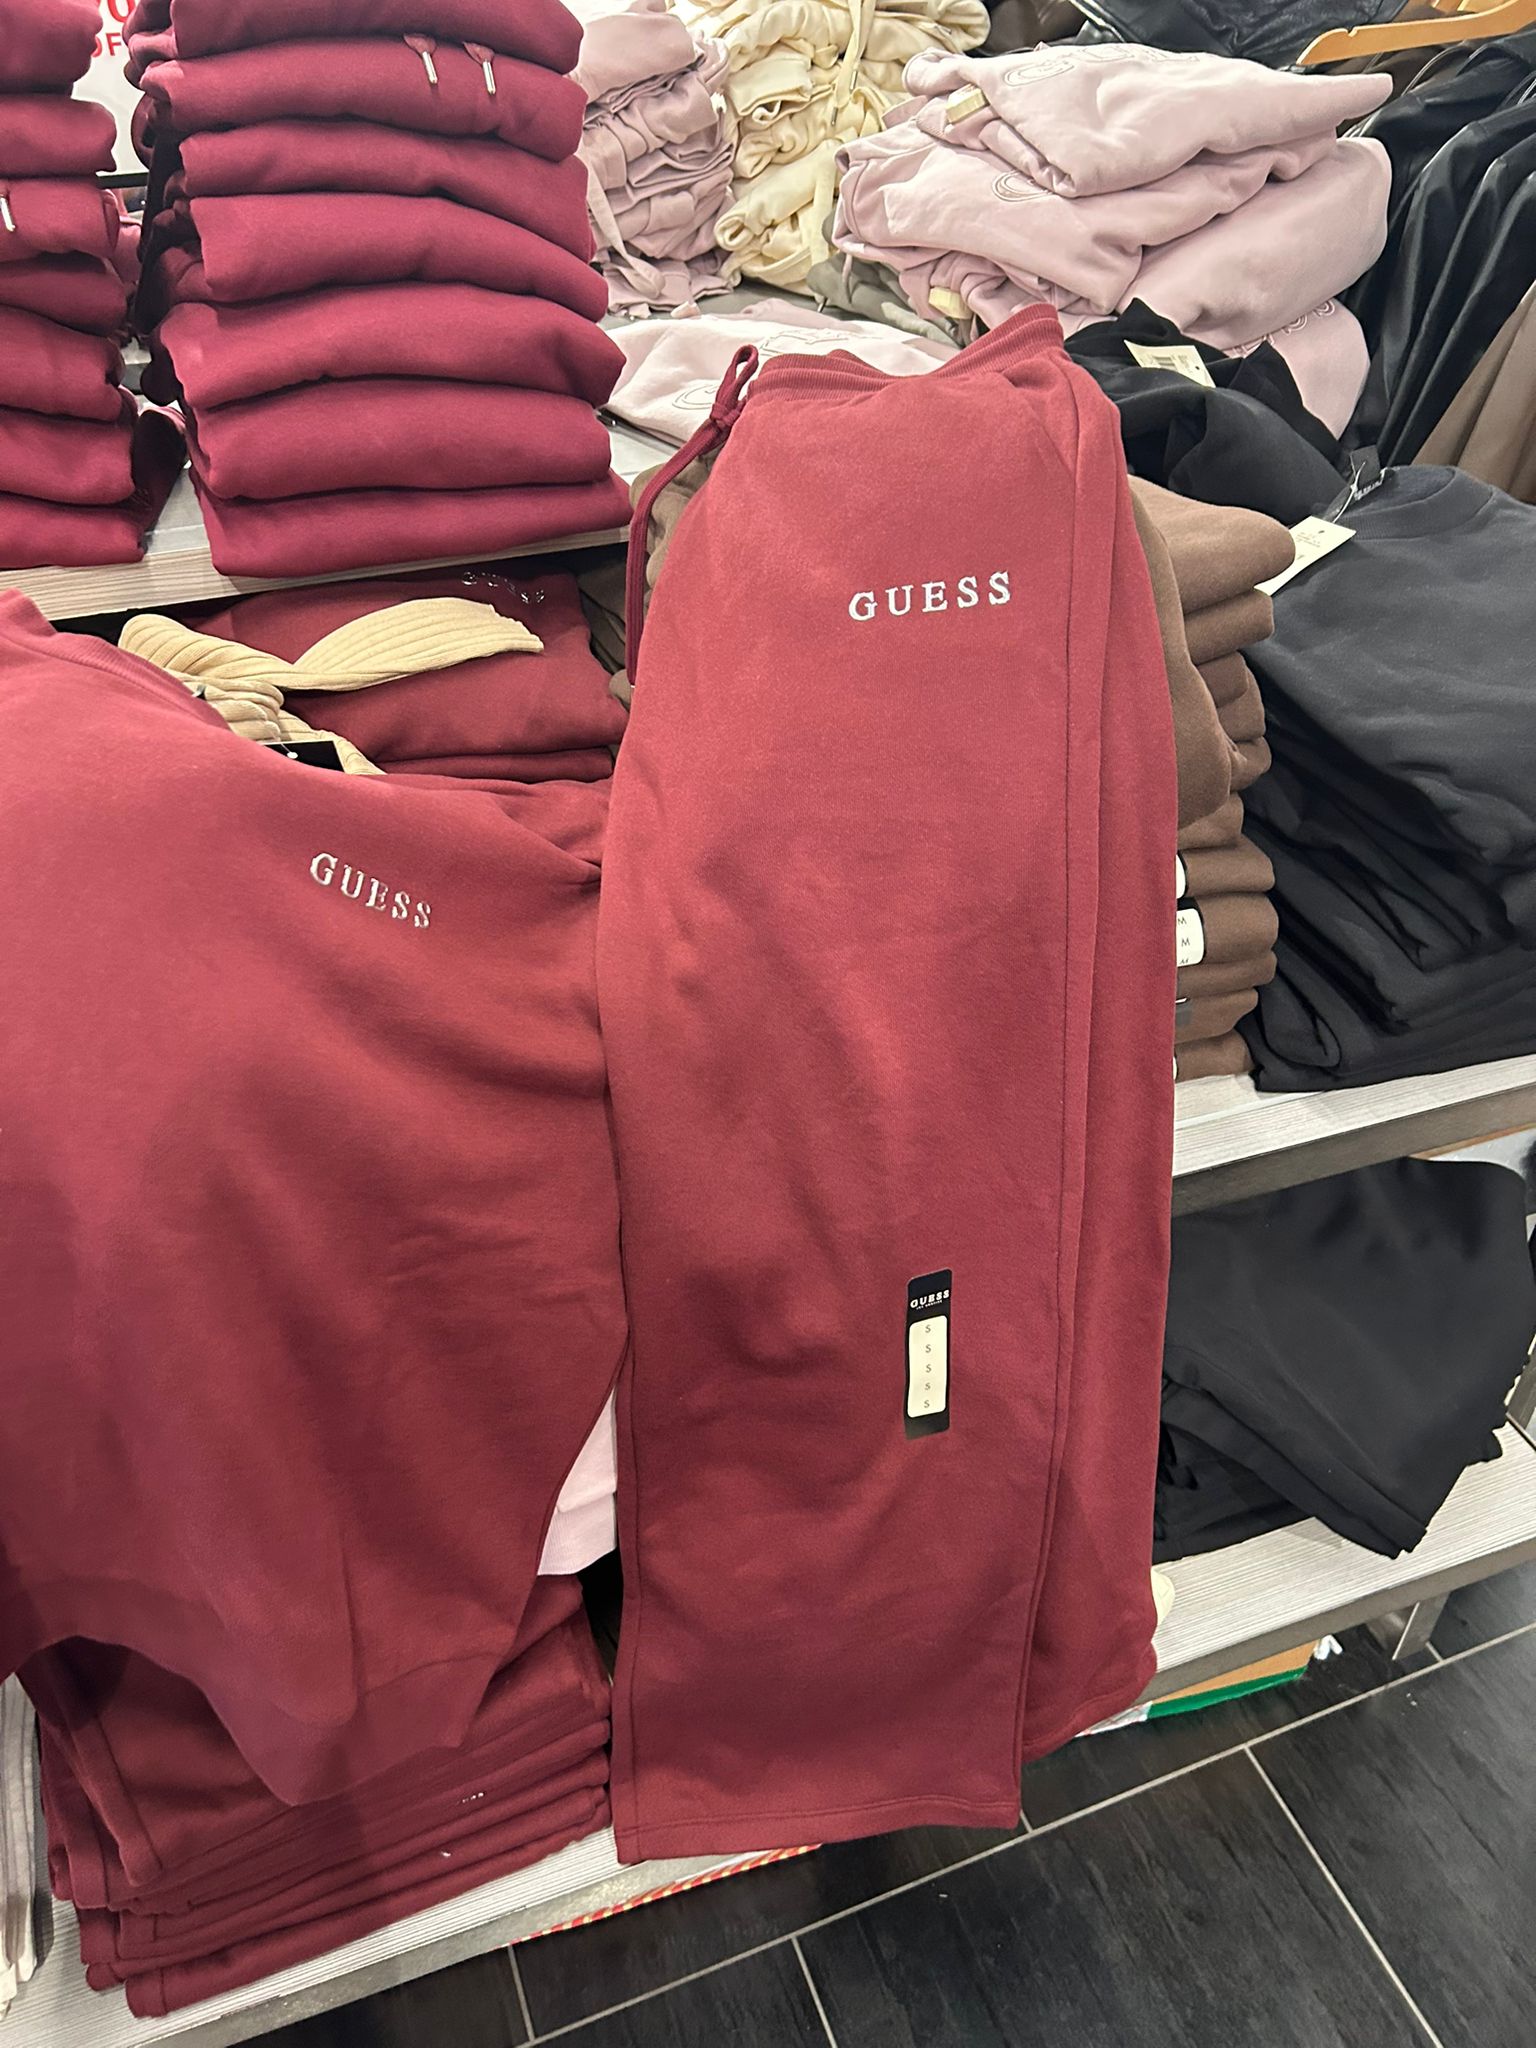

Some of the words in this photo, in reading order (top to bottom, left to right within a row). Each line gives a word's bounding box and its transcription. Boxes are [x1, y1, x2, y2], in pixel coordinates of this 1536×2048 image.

[848, 571, 1011, 621] GUESS
[309, 852, 431, 929] GUESS
[1177, 916, 1187, 926] M
[1181, 937, 1191, 947] M
[909, 1289, 950, 1309] GUESS
[924, 1324, 931, 1334] S
[925, 1344, 932, 1354] S
[925, 1363, 932, 1373] S
[924, 1382, 931, 1391] S
[923, 1399, 931, 1409] S
